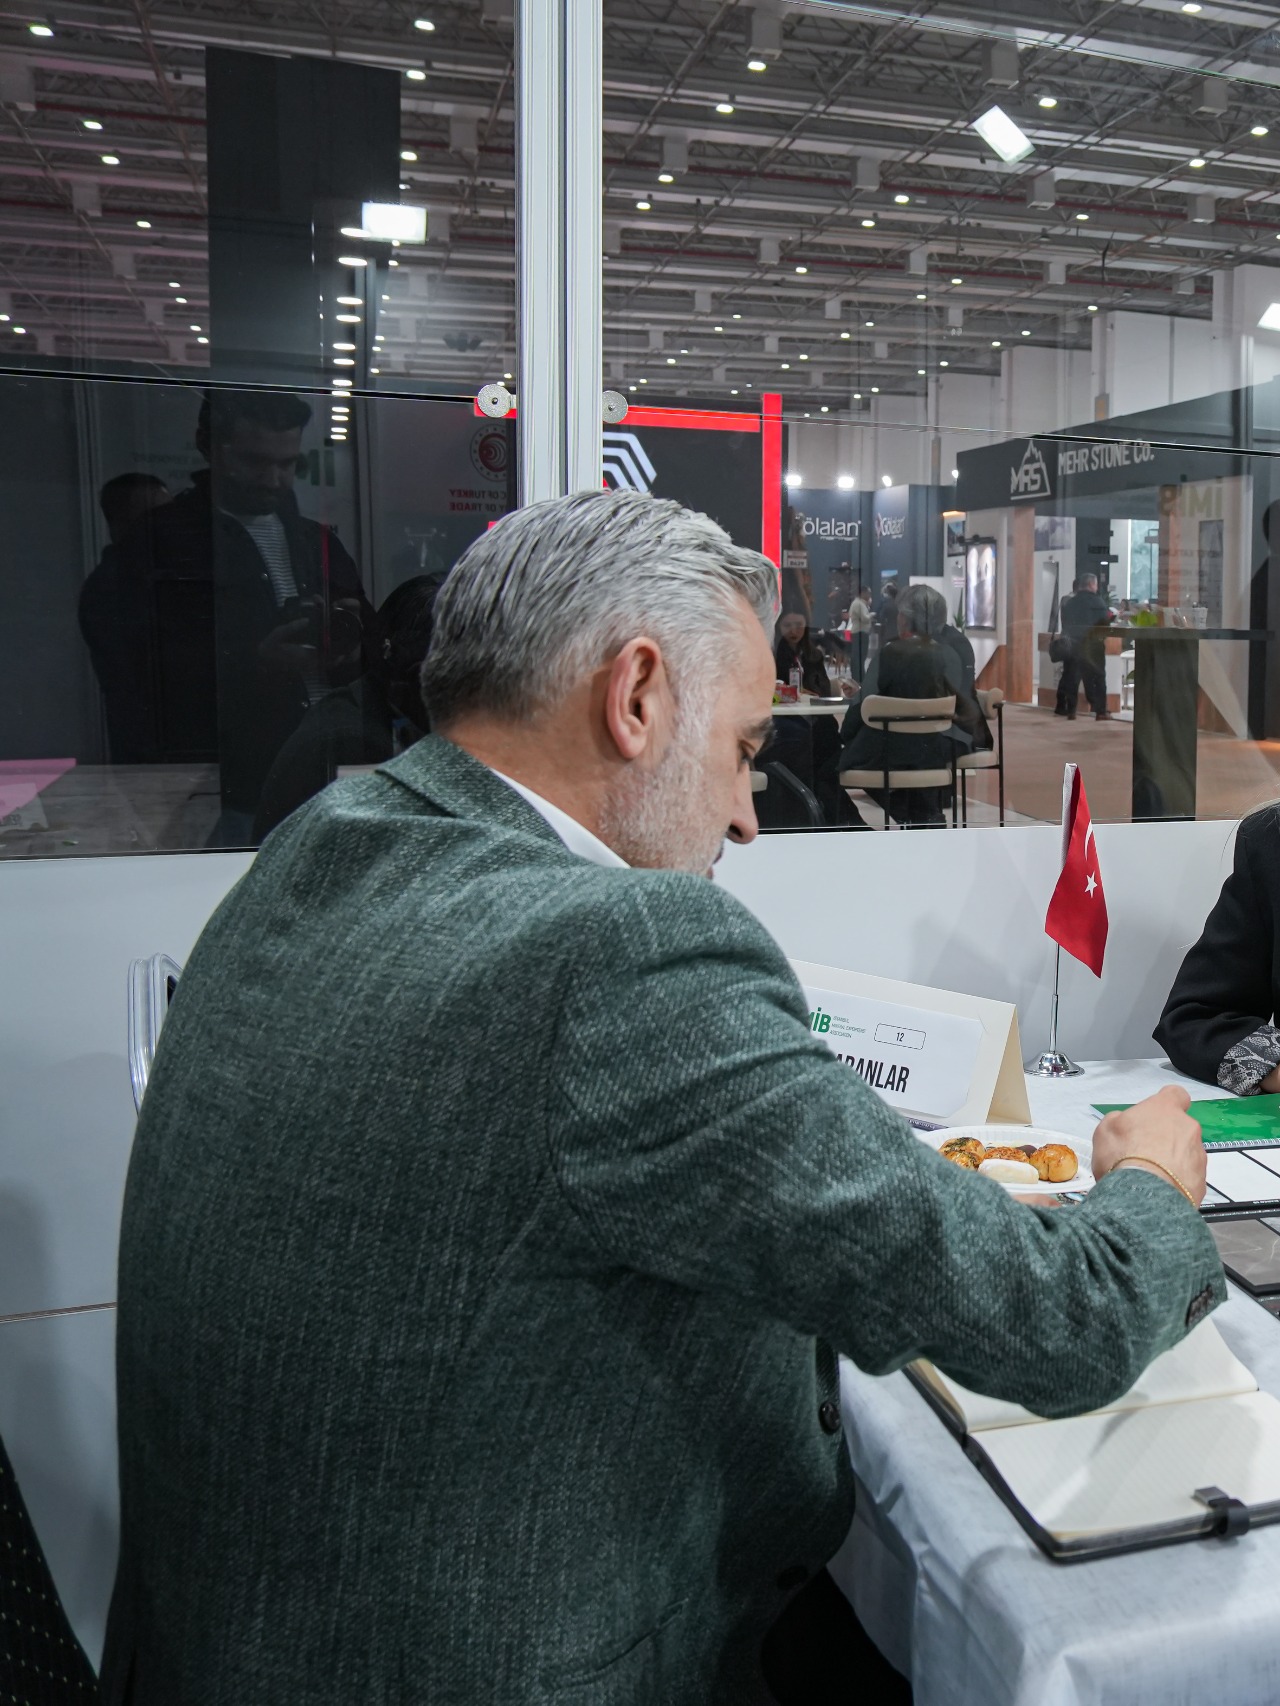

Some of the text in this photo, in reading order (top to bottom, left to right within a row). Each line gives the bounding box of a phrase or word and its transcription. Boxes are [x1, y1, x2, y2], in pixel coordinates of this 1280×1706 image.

[1058, 448, 1089, 476] MEHR
[1091, 442, 1131, 471] STONE
[803, 517, 859, 536] ölalan
[896, 1032, 905, 1042] 12
